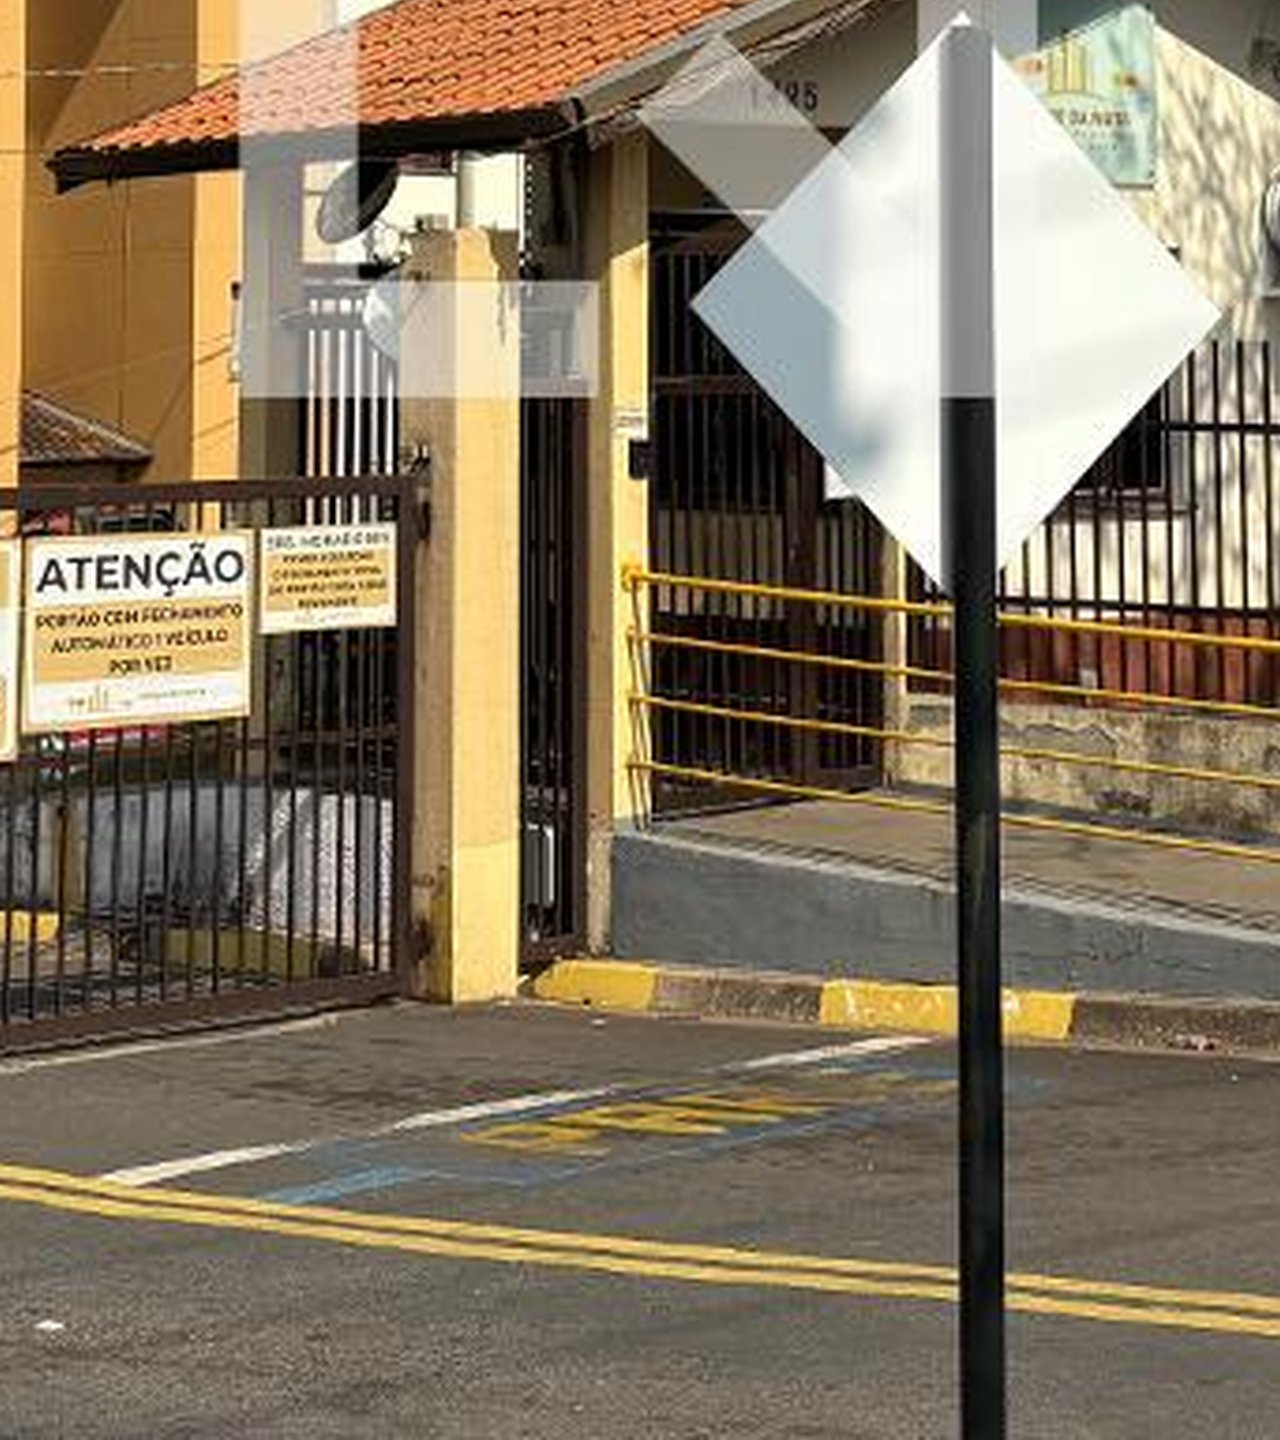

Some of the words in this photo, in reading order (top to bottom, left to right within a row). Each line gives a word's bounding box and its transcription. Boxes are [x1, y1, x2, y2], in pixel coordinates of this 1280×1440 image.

[36, 543, 244, 597] ATENÇÃO
[35, 608, 100, 630] PORTÃO
[103, 610, 139, 627] COM
[141, 603, 244, 624] FECHAMENTO
